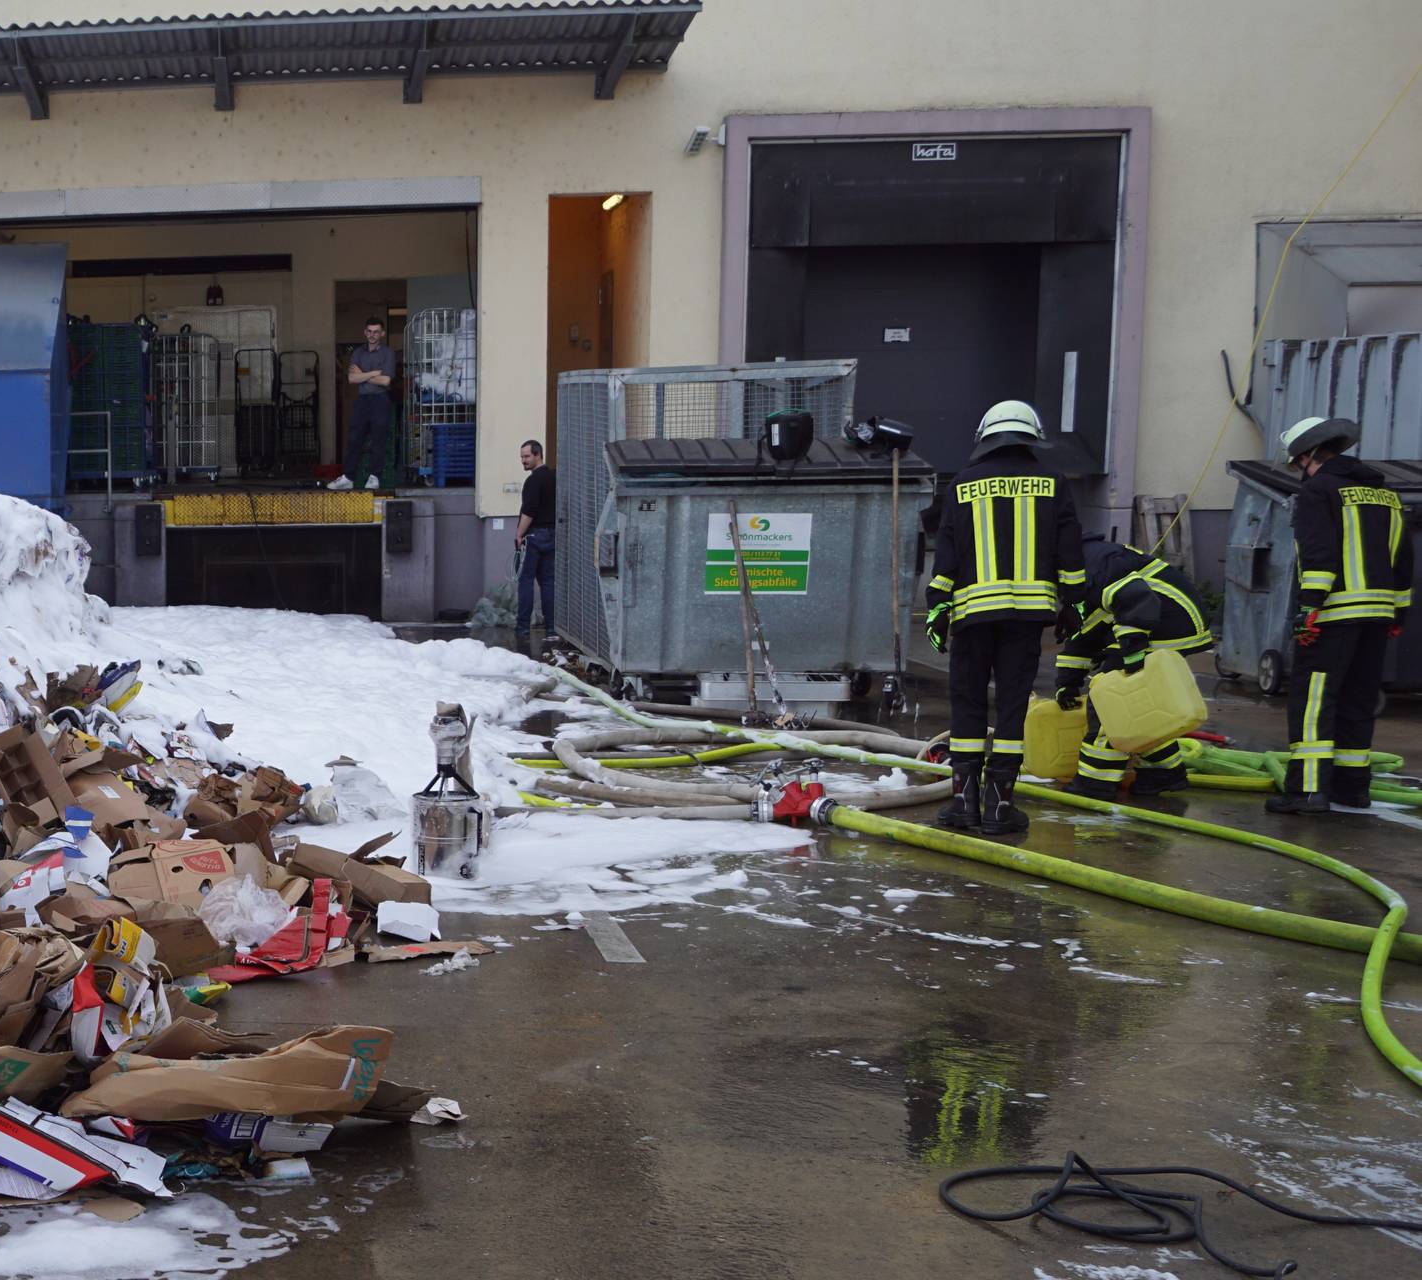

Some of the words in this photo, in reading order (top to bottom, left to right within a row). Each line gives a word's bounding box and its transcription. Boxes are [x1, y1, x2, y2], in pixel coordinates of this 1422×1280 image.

[960, 478, 1051, 501] FEUERWEHR
[1340, 488, 1399, 507] FEUERWEHR
[726, 532, 793, 541] Sönmackers
[729, 567, 784, 577] Gmischte
[714, 577, 797, 589] Siedlgsabfälle
